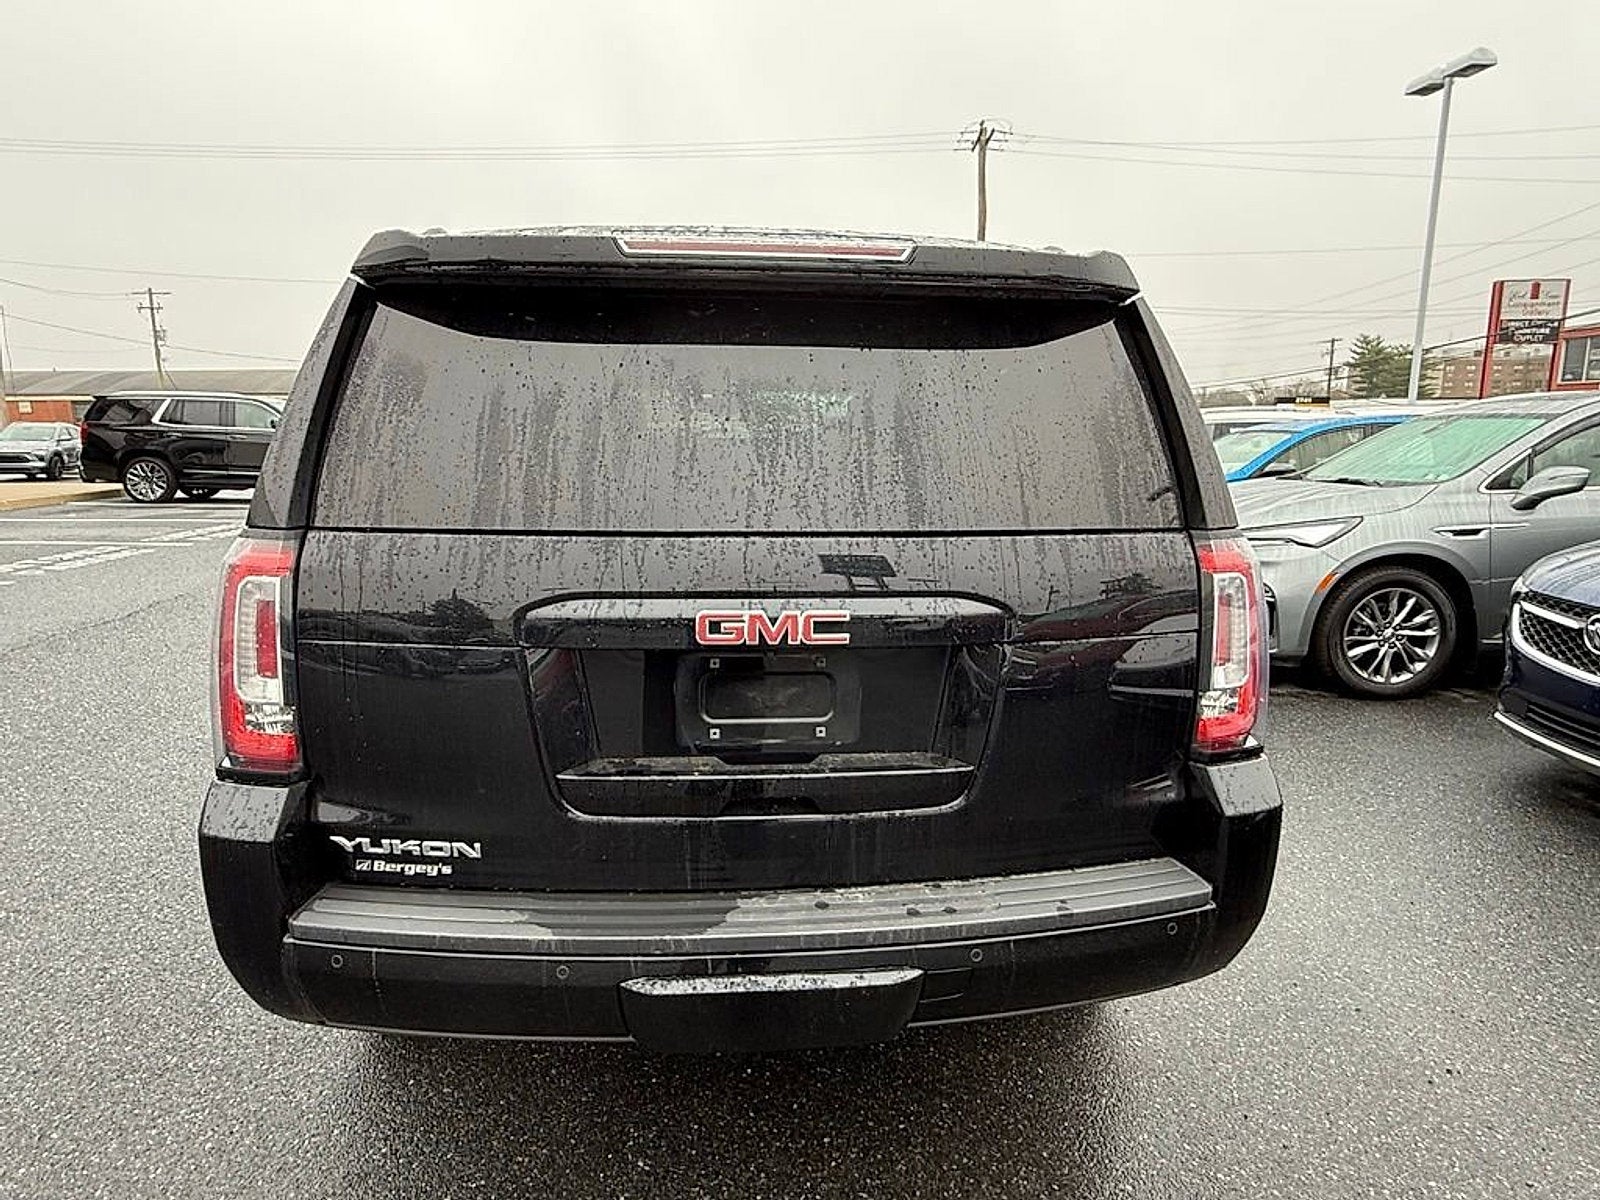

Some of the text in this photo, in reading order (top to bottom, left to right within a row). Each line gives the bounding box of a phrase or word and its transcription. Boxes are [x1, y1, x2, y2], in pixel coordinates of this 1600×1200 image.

[695, 609, 851, 645] GMC
[329, 835, 481, 859] YUKON
[373, 859, 453, 877] Bergey's
